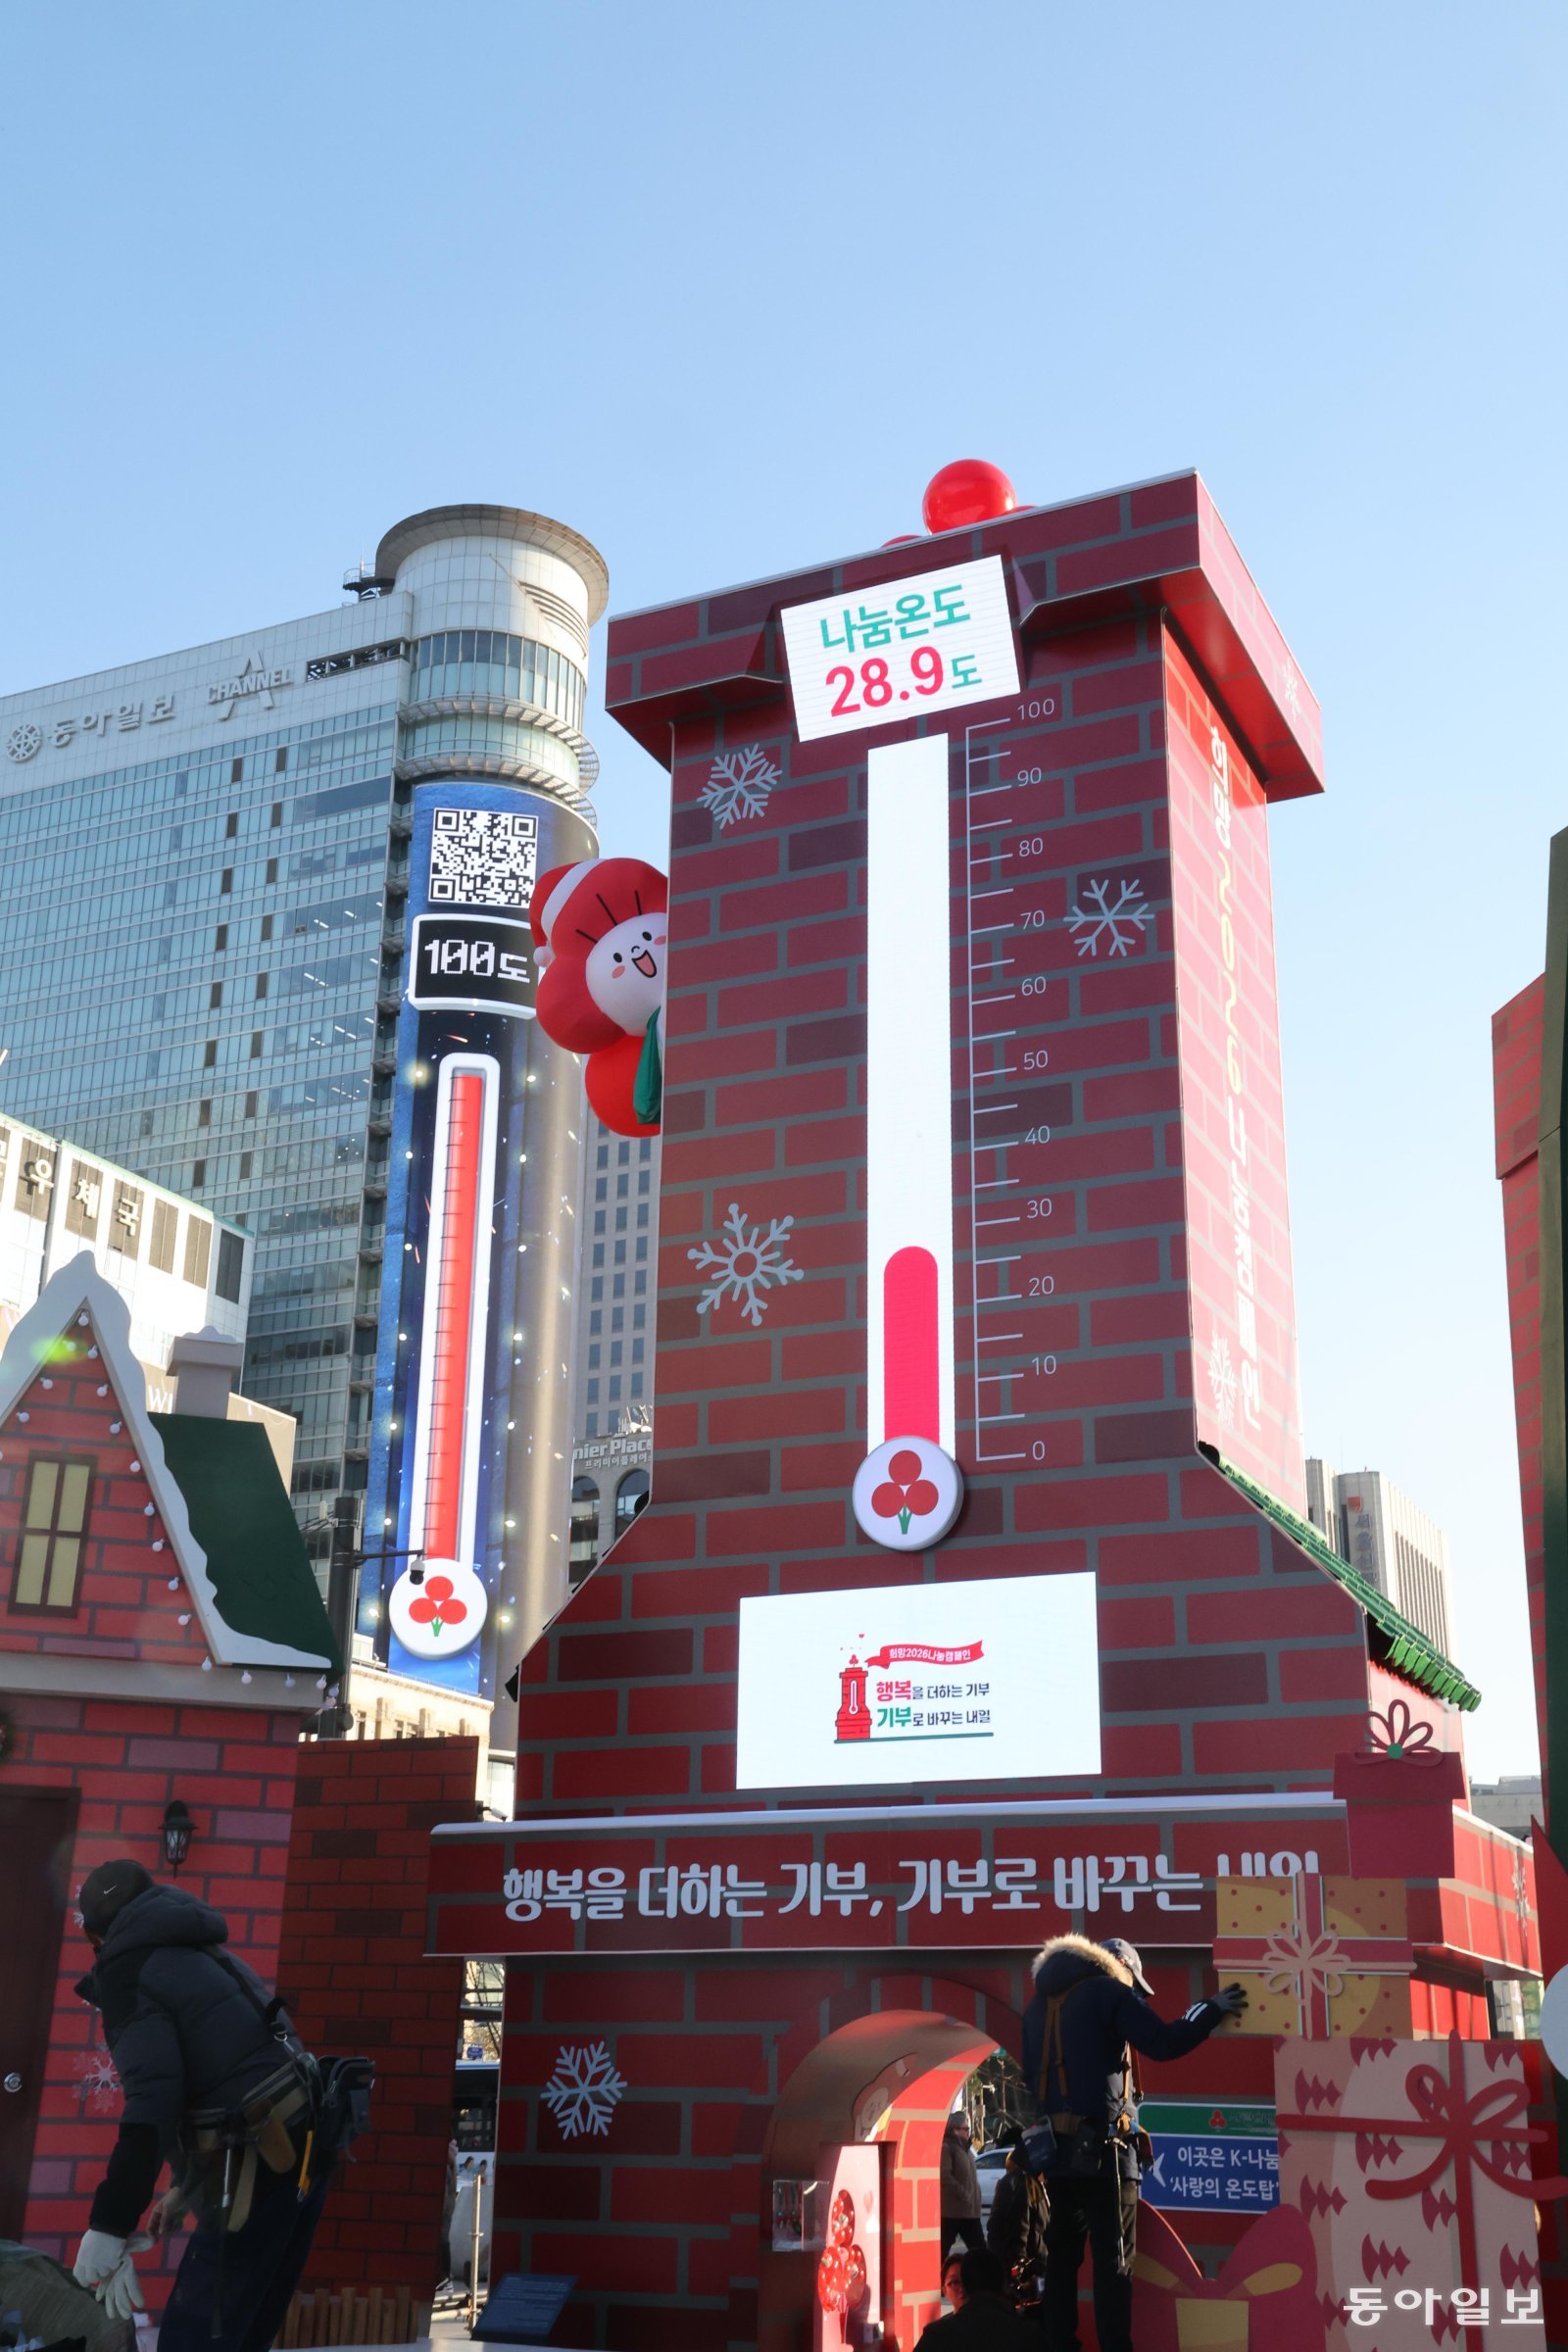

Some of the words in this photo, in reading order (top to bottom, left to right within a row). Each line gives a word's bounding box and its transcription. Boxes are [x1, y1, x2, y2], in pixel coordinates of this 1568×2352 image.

[820, 584, 970, 653] 나눔온도
[207, 668, 292, 706] CHANNEL
[825, 646, 982, 717] 28.9도
[1016, 698, 1055, 721] 100
[49, 694, 176, 748] 동아일보
[1017, 766, 1042, 787] 90
[1018, 837, 1044, 858] 80
[1020, 909, 1046, 930] 70
[424, 940, 530, 983] 100도
[1021, 976, 1047, 997] 60
[1023, 1050, 1049, 1070] 50
[1024, 1125, 1051, 1146] 40
[1026, 1198, 1053, 1219] 30
[1028, 1276, 1054, 1297] 20
[1031, 1354, 1056, 1376] 10
[1032, 1441, 1046, 1460] 0
[876, 1681, 923, 1702] 행복을
[927, 1685, 962, 1699] 더하는
[965, 1683, 990, 1696] 기부
[877, 1706, 924, 1728] 기부로
[927, 1711, 962, 1726] 바꾸는
[966, 1710, 991, 1724] 내일
[503, 1867, 627, 1922] 행복을
[638, 1863, 767, 1920] 더하는
[778, 1862, 884, 1918] 기부,
[897, 1858, 1041, 1915] 기부로
[1054, 1854, 1203, 1913] 바꾸는
[1177, 2145, 1225, 2168] 이곳은
